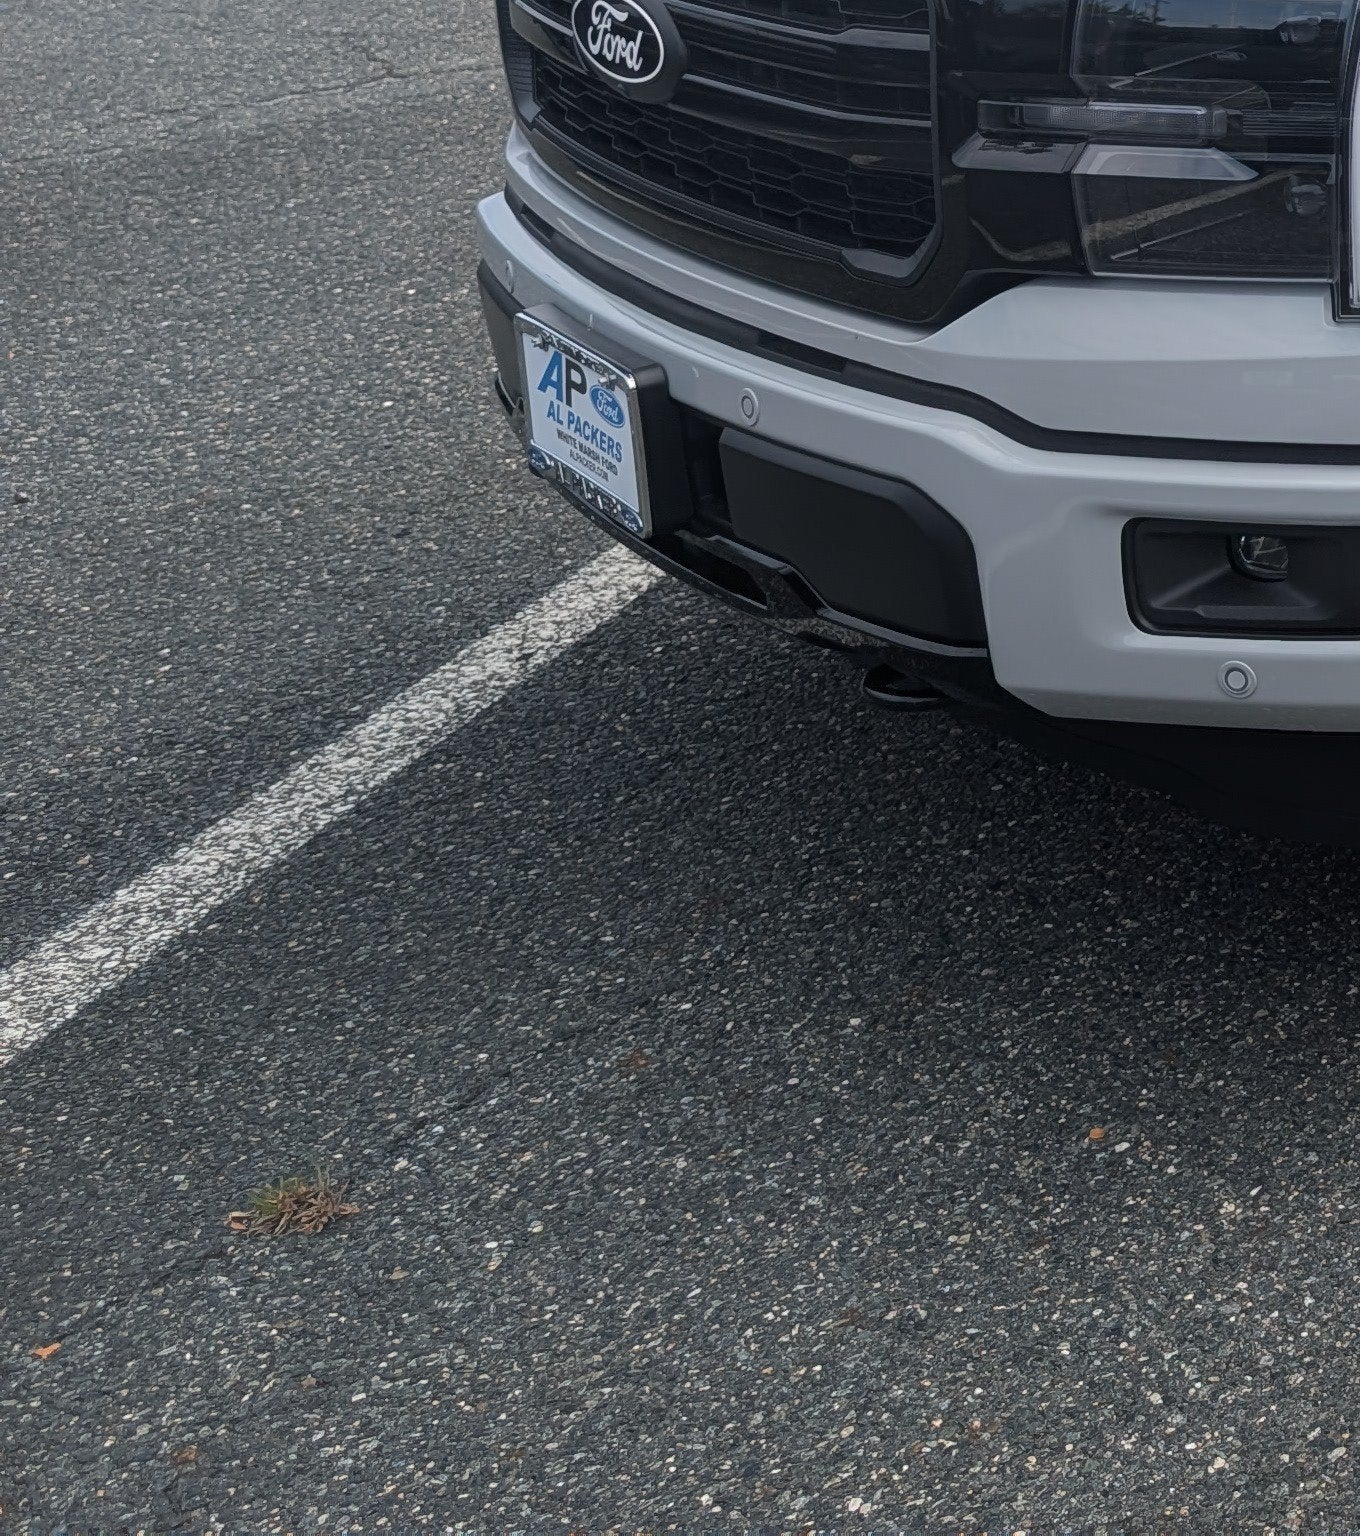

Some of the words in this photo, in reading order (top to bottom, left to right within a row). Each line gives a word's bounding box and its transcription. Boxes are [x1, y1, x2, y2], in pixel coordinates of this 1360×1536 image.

[588, 0, 643, 72] Ford
[537, 351, 587, 407] AP
[546, 401, 564, 426] AL
[567, 412, 622, 463] PACKERS
[601, 456, 618, 476] FORD
